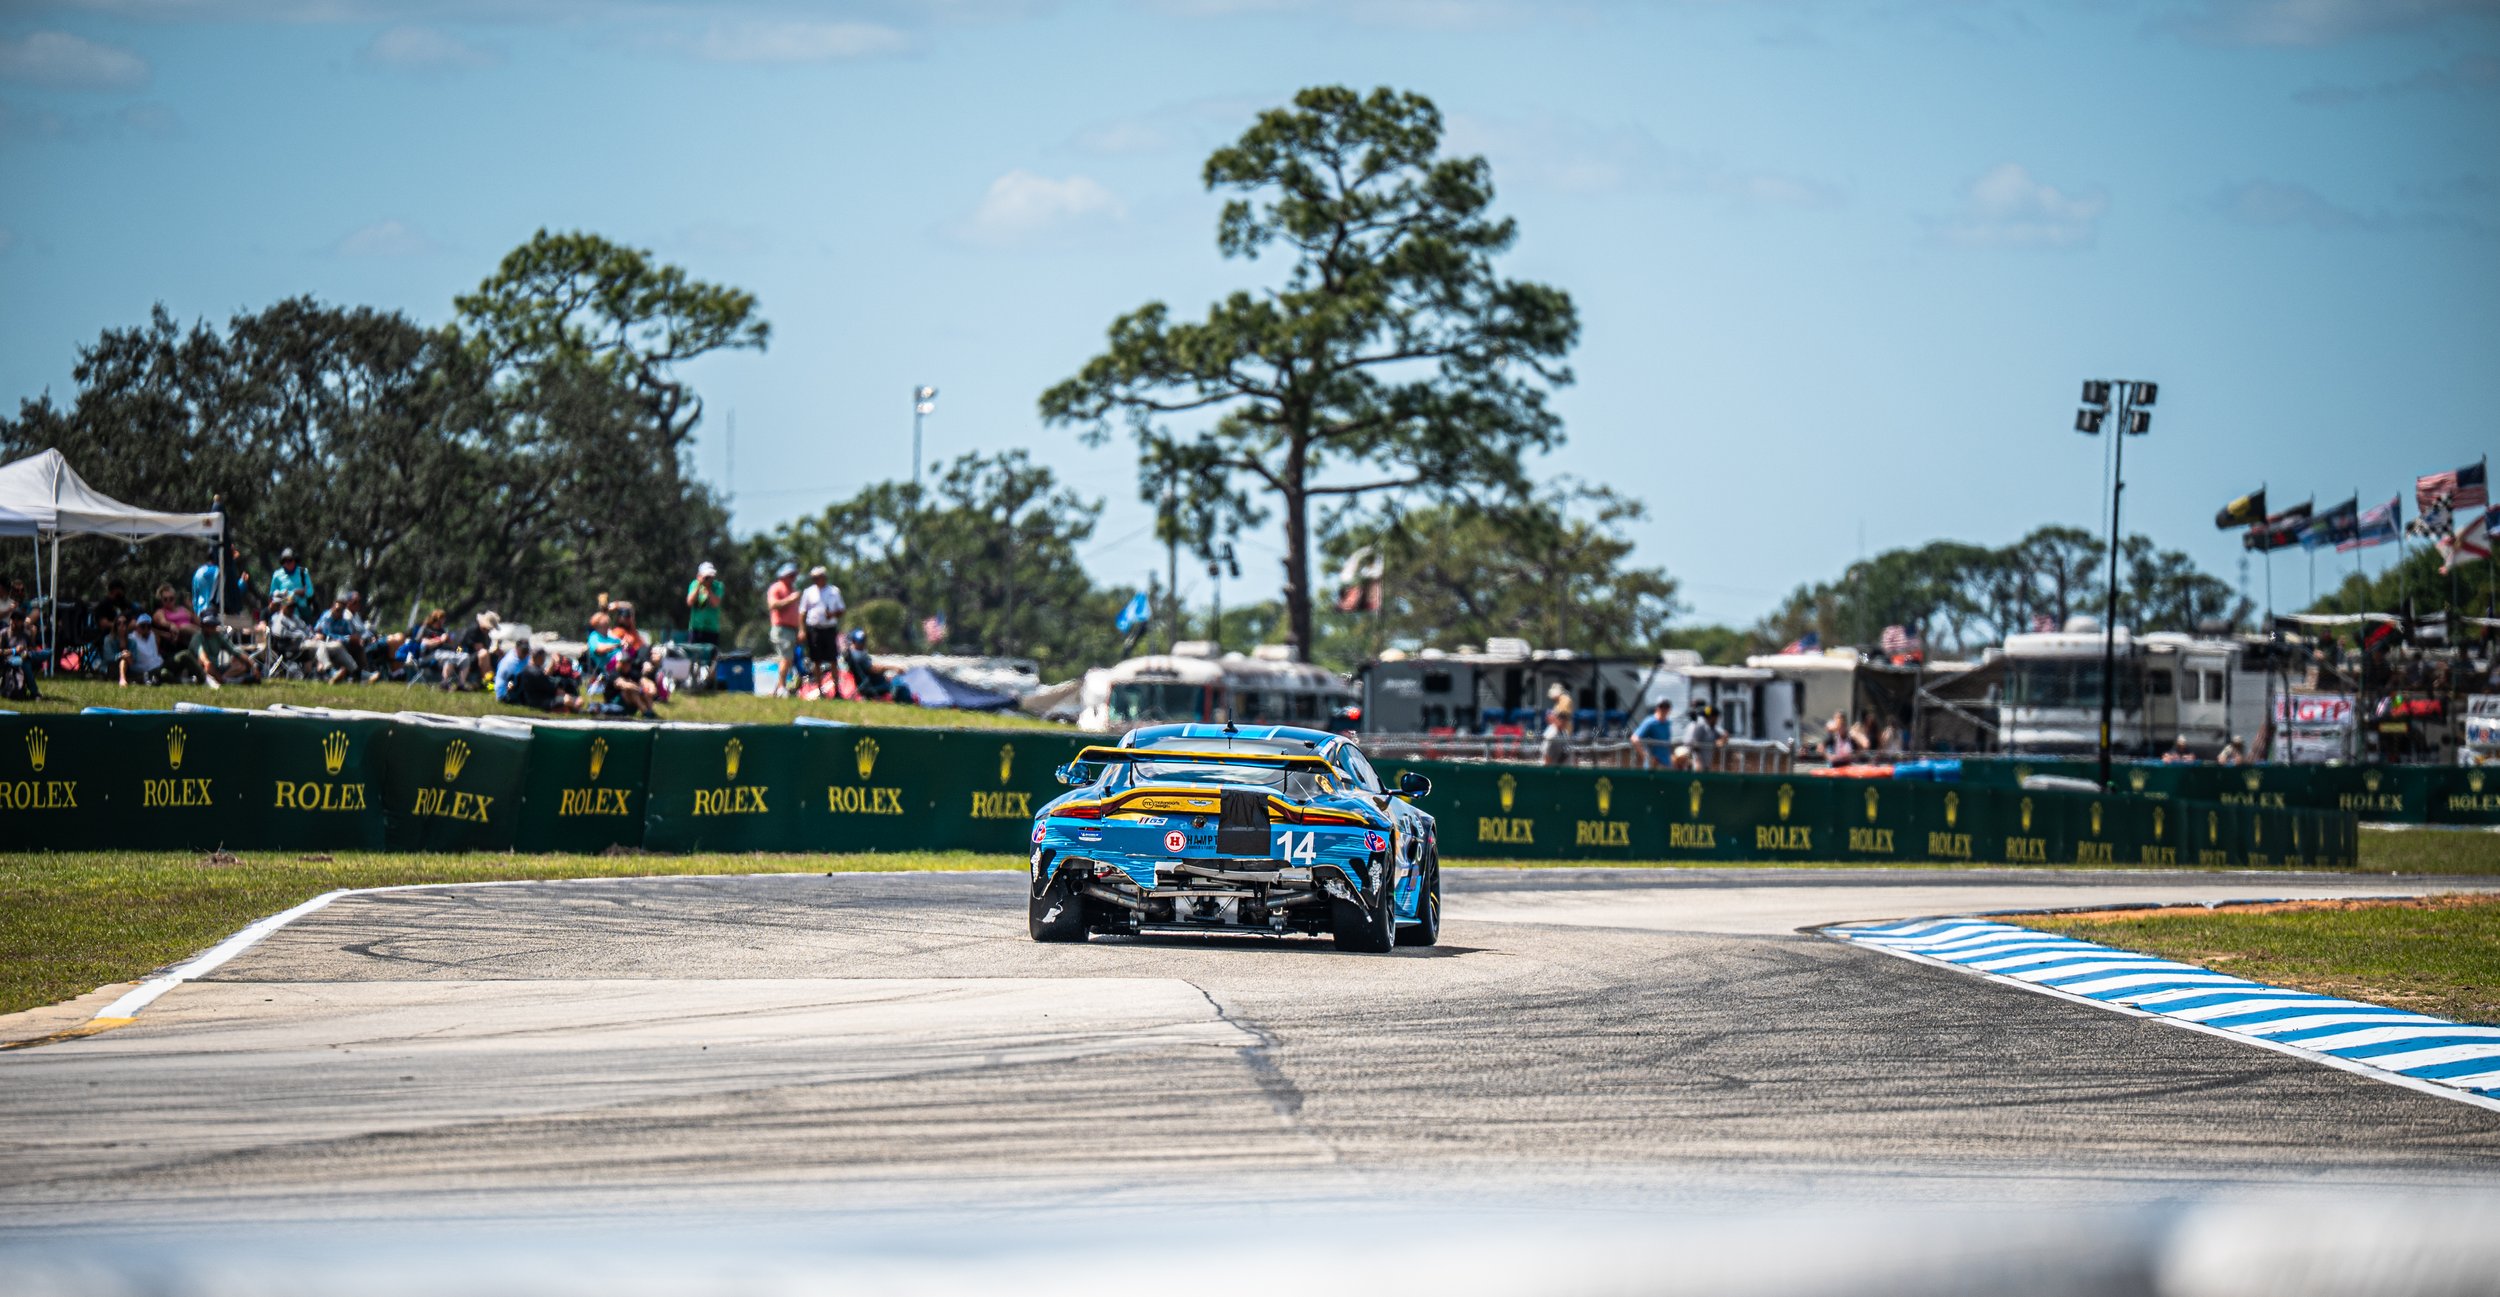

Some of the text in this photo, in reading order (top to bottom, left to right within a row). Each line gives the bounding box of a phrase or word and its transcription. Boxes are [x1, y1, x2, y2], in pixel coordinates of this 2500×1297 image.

[2298, 700, 2349, 720] GTP
[0, 781, 77, 809] ROLEX
[143, 779, 212, 807] ROLEX
[275, 781, 366, 811] ROLEX
[413, 788, 494, 823] ROLEX
[559, 788, 632, 816] ROLEX
[693, 786, 769, 816] ROLEX
[829, 786, 904, 815] ROLEX
[971, 791, 1032, 818] ROLEX
[2340, 792, 2404, 811] ROLEX
[1478, 817, 1534, 843] ROLEX
[1576, 821, 1631, 846] ROLEX
[1670, 823, 1716, 848] ROLEX
[1756, 826, 1812, 850] ROLEX
[1849, 828, 1894, 853] ROLEX
[1276, 831, 1317, 865] 14
[1928, 832, 1972, 857] ROLEX
[2006, 837, 2046, 861] ROLEX
